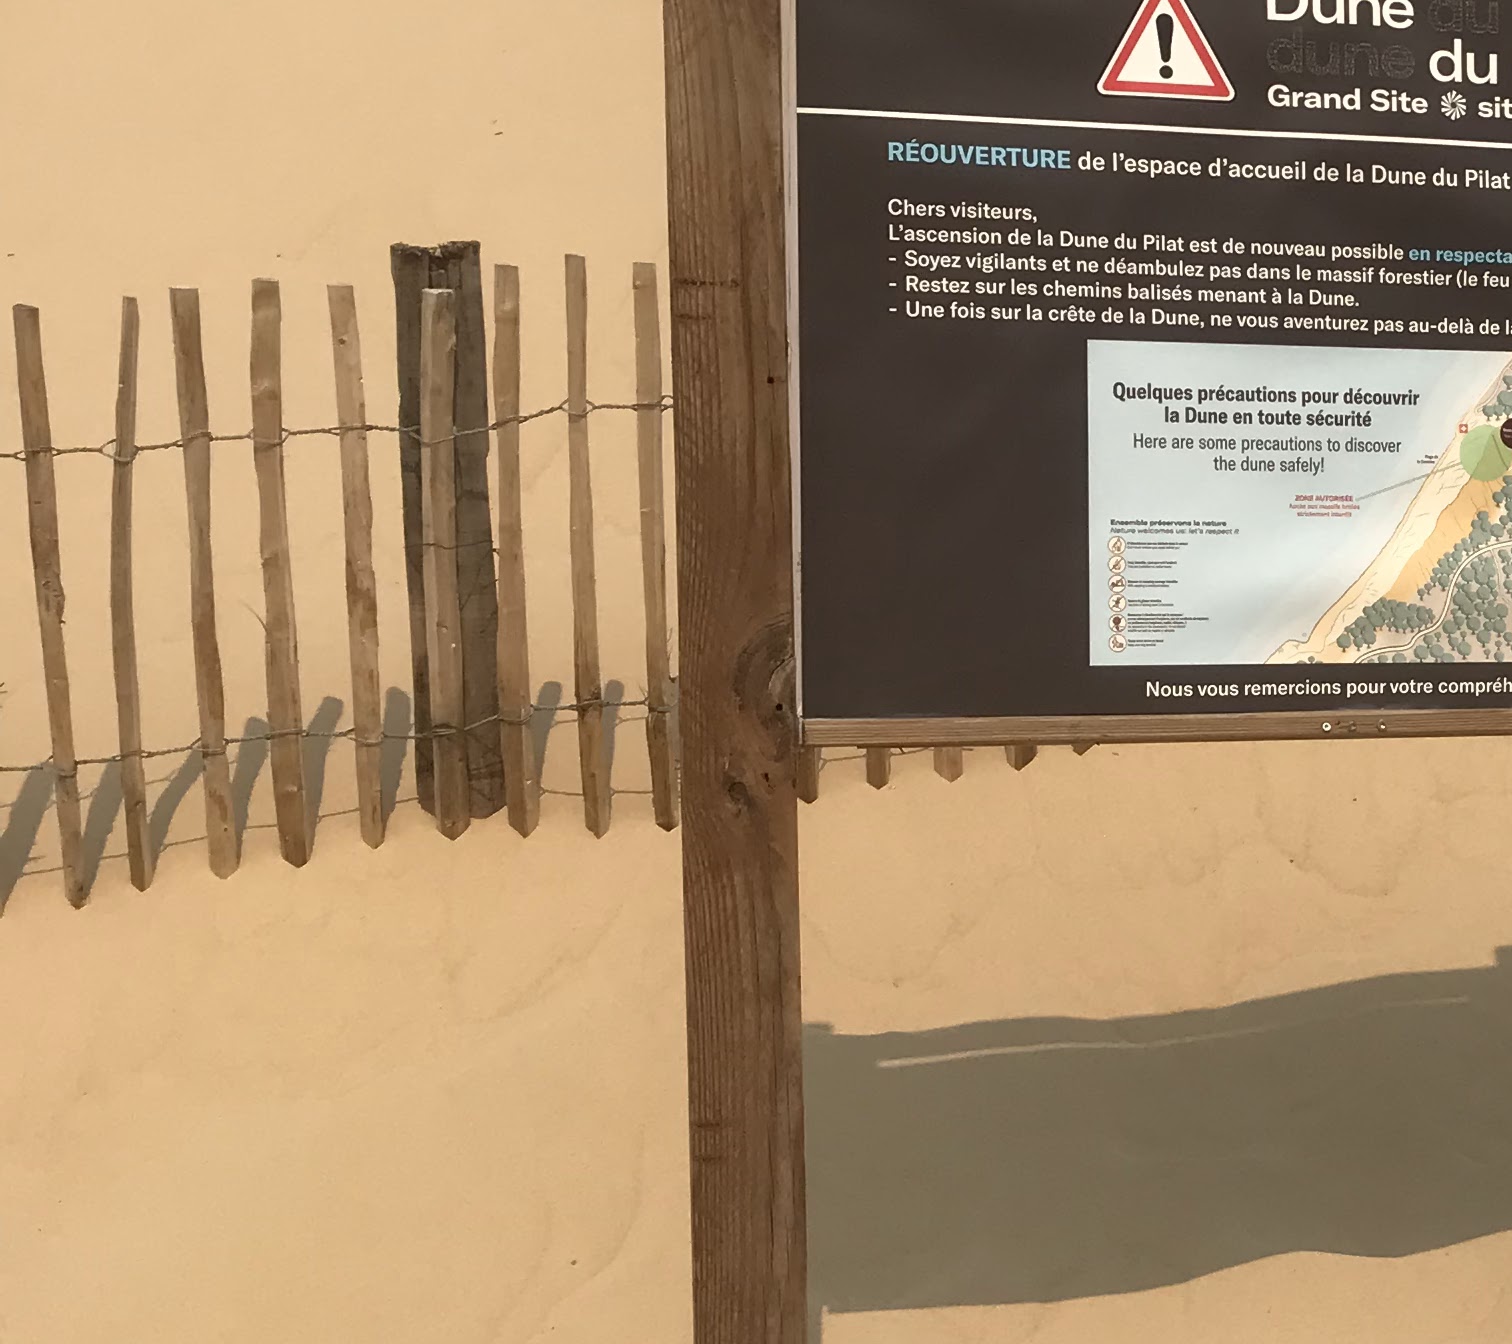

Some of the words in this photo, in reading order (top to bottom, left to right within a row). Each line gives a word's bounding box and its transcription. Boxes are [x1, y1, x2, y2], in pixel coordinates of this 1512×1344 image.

[1266, 32, 1415, 79] dune
[1429, 38, 1497, 84] du
[1268, 84, 1360, 110] Grand
[1370, 89, 1428, 113] Site
[888, 139, 1071, 169] RÉOUVERTURE
[1078, 151, 1105, 171] de
[1113, 152, 1201, 178] l’espace
[1208, 158, 1306, 180] d’accueil
[1314, 162, 1339, 181] de
[1347, 163, 1364, 182] la
[1372, 165, 1426, 185] Dune
[1433, 168, 1457, 186] du
[1466, 169, 1510, 189] Pilat
[888, 199, 945, 217] Chers
[950, 202, 1037, 223] visiteurs,
[889, 224, 1001, 244] L’ascension
[1008, 228, 1031, 245] de
[1038, 229, 1053, 246] la
[1060, 231, 1109, 248] Dune
[1114, 233, 1136, 249] du
[1144, 235, 1184, 252] Pilat
[1190, 238, 1217, 253] est
[1223, 238, 1245, 254] de
[1251, 243, 1325, 257] nouveau
[1332, 243, 1403, 261] possible
[1409, 249, 1430, 260] en
[905, 250, 961, 271] Soyez
[966, 253, 1047, 273] vigilants
[1052, 257, 1070, 272] et
[1077, 261, 1098, 273] ne
[1104, 257, 1204, 277] déambulez
[1210, 266, 1241, 281] pas
[1247, 263, 1290, 280] dans
[1297, 264, 1311, 280] le
[1316, 267, 1374, 283] massif
[1379, 268, 1452, 285] forestier
[1457, 270, 1478, 288] (le
[1483, 271, 1509, 287] feu
[906, 276, 970, 293] Restez
[975, 282, 1006, 294] sur
[1011, 278, 1037, 295] les
[1043, 280, 1122, 298] chemins
[1128, 283, 1192, 301] balisés
[1198, 289, 1266, 303] menant
[1272, 288, 1281, 304] à
[1288, 288, 1303, 304] la
[1310, 290, 1359, 306] Dune.
[906, 301, 944, 317] Une
[950, 302, 985, 319] fois
[991, 307, 1021, 320] sur
[1027, 304, 1042, 320] la
[1048, 305, 1095, 322] crête
[1101, 307, 1123, 323] de
[1130, 308, 1145, 324] la
[1152, 309, 1204, 328] Dune,
[1211, 315, 1232, 326] ne
[1237, 316, 1278, 328] vous
[1284, 315, 1368, 331] aventurez
[1374, 320, 1404, 335] pas
[1409, 318, 1474, 334] au-delà
[1479, 319, 1500, 335] de
[1113, 382, 1193, 404] Quelques
[1198, 385, 1296, 404] précautions
[1302, 391, 1339, 407] pour
[1343, 388, 1420, 405] découvrir
[1165, 406, 1179, 423] la
[1185, 407, 1228, 424] Dune
[1233, 412, 1252, 424] en
[1257, 410, 1301, 425] toute
[1306, 410, 1371, 427] sécurité
[1134, 433, 1167, 449] Here
[1172, 438, 1194, 449] are
[1199, 438, 1236, 450] some
[1241, 436, 1322, 454] precautions
[1327, 438, 1340, 452] to
[1345, 437, 1401, 453] discover
[1213, 455, 1236, 471] the
[1241, 456, 1275, 472] dune
[1280, 457, 1324, 476] safely!
[1147, 681, 1193, 697] Nous
[1197, 684, 1239, 696] vous
[1245, 679, 1341, 695] remercions
[1347, 683, 1386, 698] pour
[1390, 680, 1433, 693] votre
